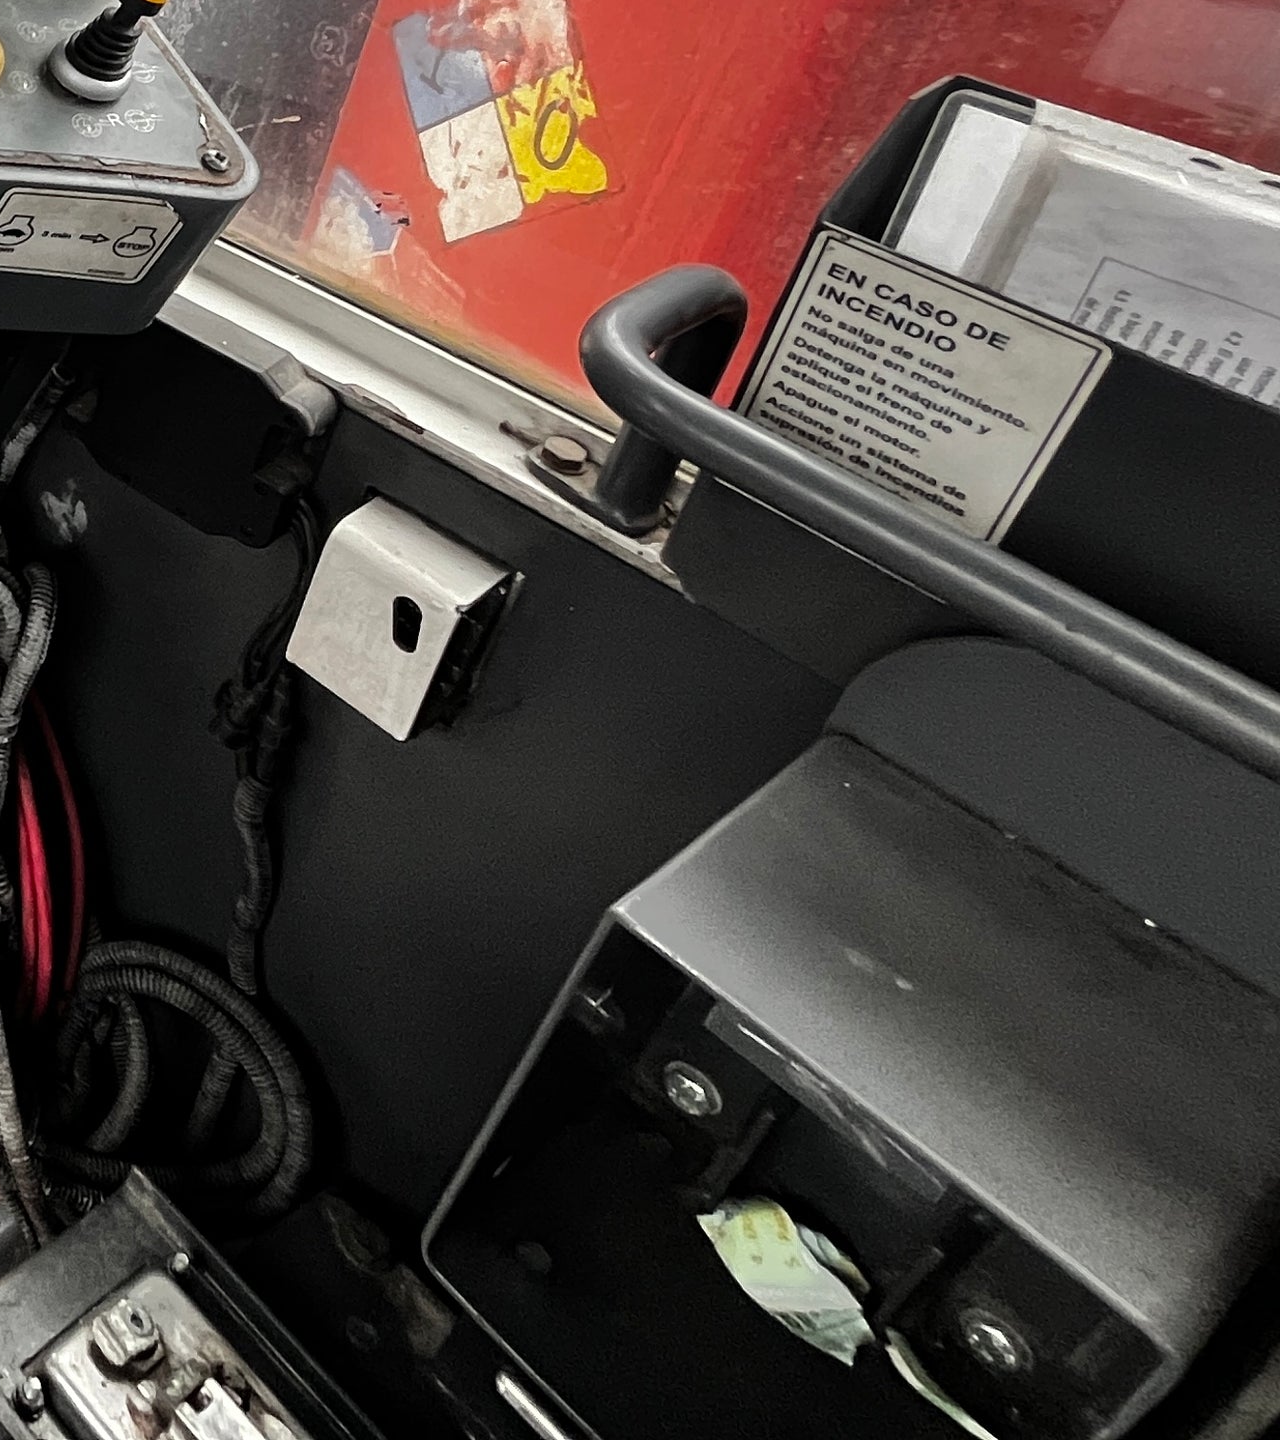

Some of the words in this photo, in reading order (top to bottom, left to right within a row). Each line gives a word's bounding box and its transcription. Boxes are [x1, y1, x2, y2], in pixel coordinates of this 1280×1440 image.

[107, 113, 125, 128] R
[533, 96, 579, 171] 0
[116, 240, 151, 251] STOP
[808, 306, 833, 323] No
[837, 320, 885, 349] salga
[891, 345, 914, 360] de
[919, 358, 955, 379] una
[817, 283, 956, 352] INCENDIO
[827, 263, 868, 289] EN
[874, 283, 958, 327] CASO
[964, 321, 1011, 351] DE
[780, 364, 931, 443] estacionamiento.
[787, 351, 850, 386] aplique
[855, 384, 872, 396] el
[876, 392, 925, 421] freno
[930, 419, 953, 434] de
[793, 336, 865, 377] Detenga
[870, 372, 887, 386] la
[892, 382, 973, 427] máquina
[976, 425, 992, 435] y
[801, 320, 878, 361] máquina
[882, 358, 905, 373] en
[910, 371, 1029, 431] movimiento.
[765, 396, 835, 435] Accione
[839, 433, 862, 449] un
[867, 446, 937, 487] sistema
[942, 484, 967, 501] de
[773, 380, 839, 417] Apague
[843, 414, 860, 427] el
[863, 424, 921, 458] motor.
[849, 453, 870, 470] de
[875, 465, 966, 517] incendios
